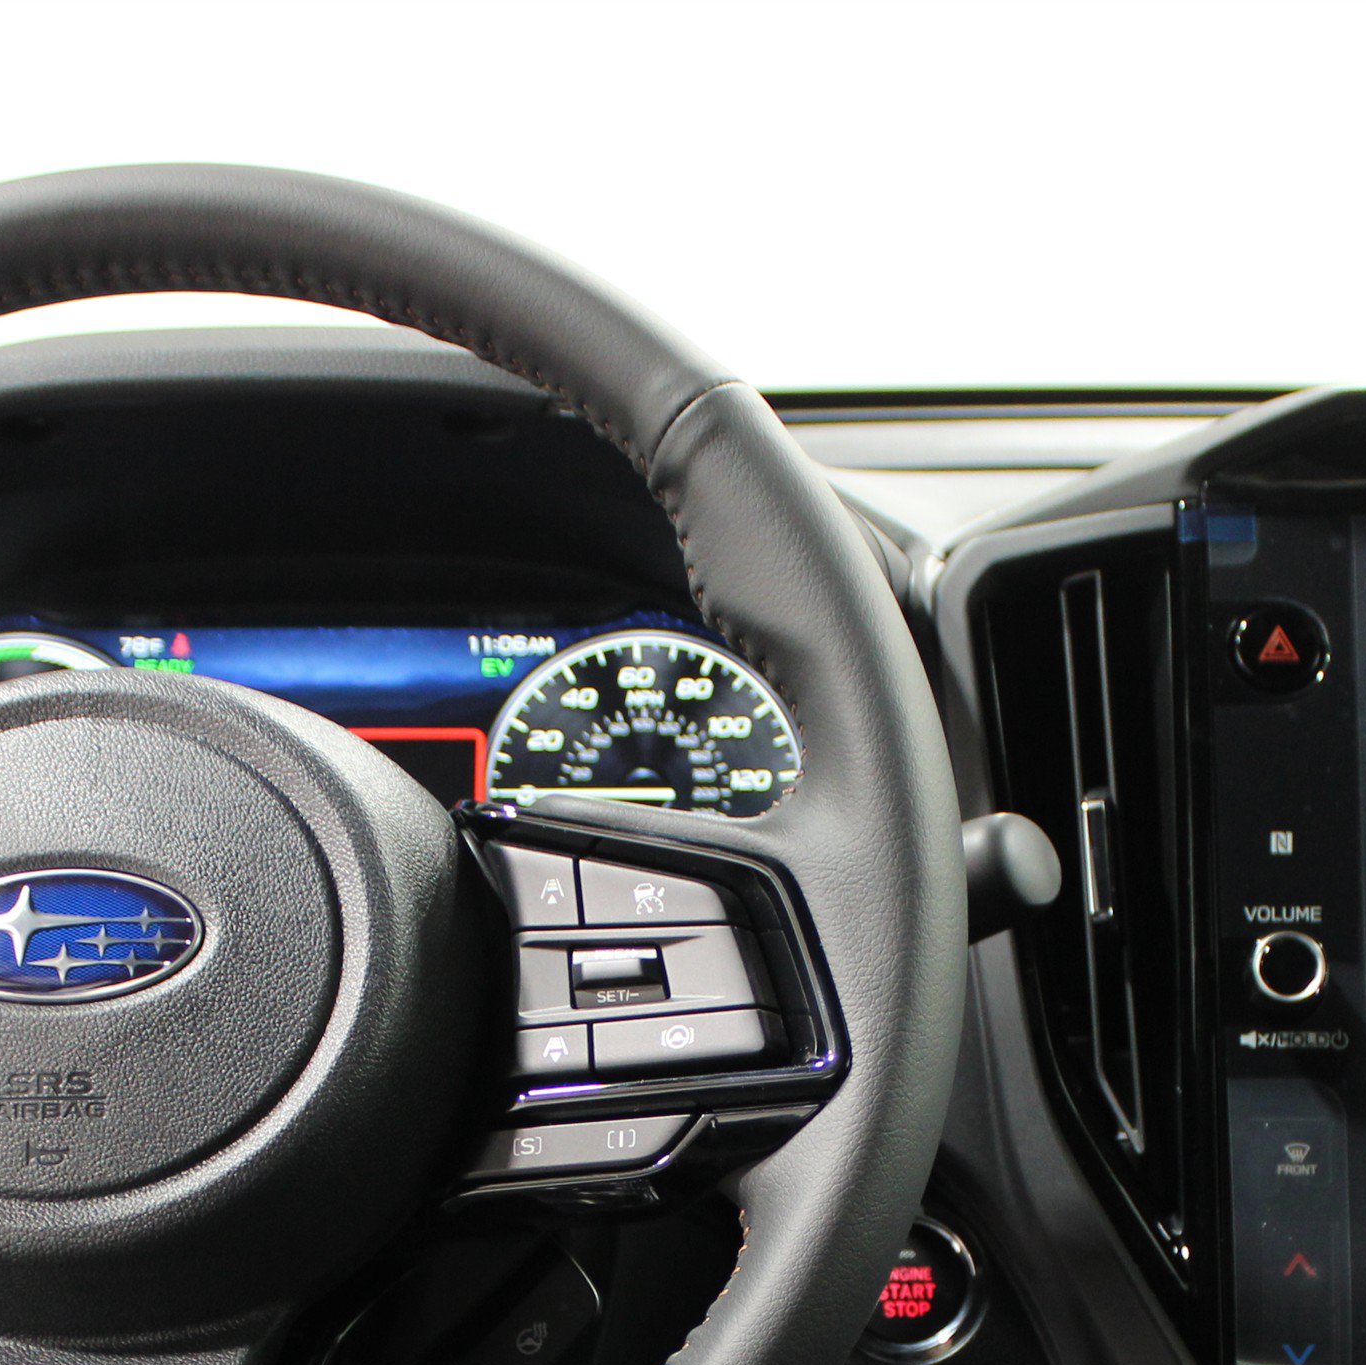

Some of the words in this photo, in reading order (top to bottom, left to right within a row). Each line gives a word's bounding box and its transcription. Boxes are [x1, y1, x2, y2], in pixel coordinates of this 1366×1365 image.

[481, 657, 514, 677] EV
[617, 666, 655, 689] 60
[675, 677, 714, 699] 80
[560, 687, 599, 710] 40
[625, 690, 665, 708] MPH
[708, 716, 752, 738] 100
[526, 730, 564, 751] 20
[729, 769, 773, 791] 120
[1244, 905, 1323, 923] VOLUME
[6, 1072, 94, 1095] SRS
[1277, 1164, 1317, 1176] FRONT
[889, 1266, 933, 1281] NGINE
[879, 1282, 937, 1301] START
[883, 1301, 932, 1318] STOP
